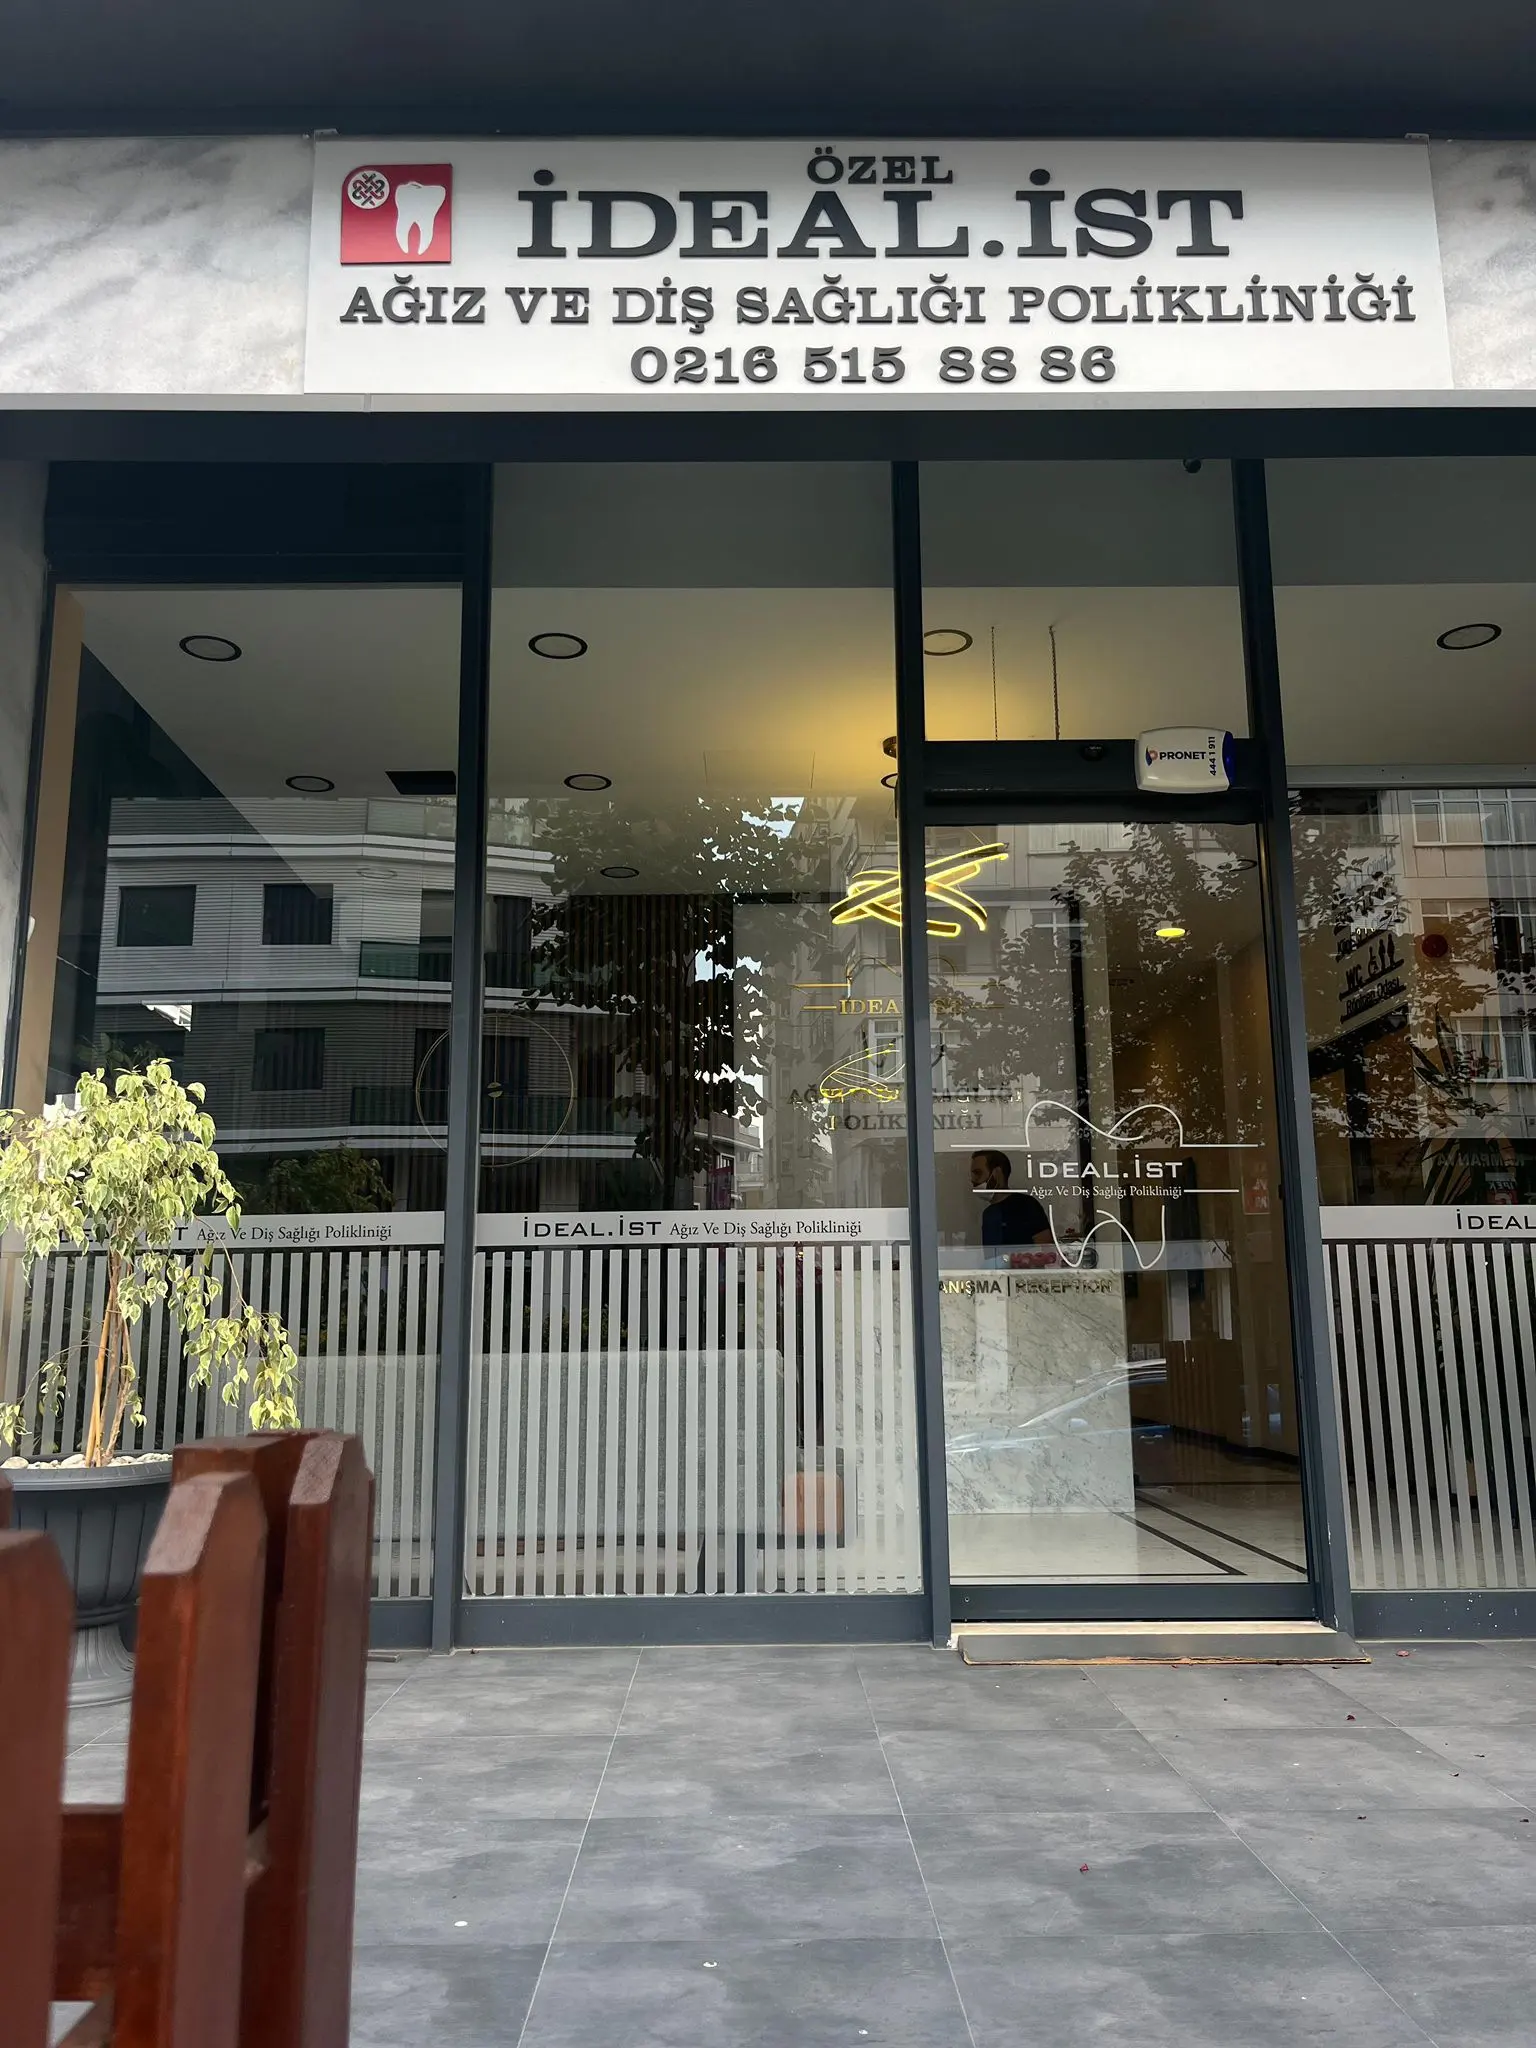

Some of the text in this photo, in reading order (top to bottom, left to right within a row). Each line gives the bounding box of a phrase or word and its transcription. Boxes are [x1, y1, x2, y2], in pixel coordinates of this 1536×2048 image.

[806, 146, 955, 184] ÖZEL
[517, 168, 1243, 258] İDEAL.İST
[340, 273, 1416, 334] AĞIZ VE DİŞ SAĞLIĞI POLİKLİNİĞİ
[630, 346, 1116, 384] 0216 515 88 86
[1208, 736, 1216, 749] 911
[1159, 751, 1207, 760] PRONET
[1209, 758, 1217, 776] 444
[1027, 1154, 1183, 1179] İDEAL.İST
[1030, 1185, 1182, 1200] Ağız Ve Diş Sağlığı Polikliniği
[231, 1229, 247, 1240] Ve
[252, 1226, 274, 1242] Diş
[278, 1226, 320, 1243] Sağlığı
[325, 1225, 392, 1242] Polikliniği
[523, 1215, 862, 1240] İDEAL.İST Ağız Ve Diş Sağlığı Polikliniği
[939, 1279, 1002, 1298] ANIŞMA
